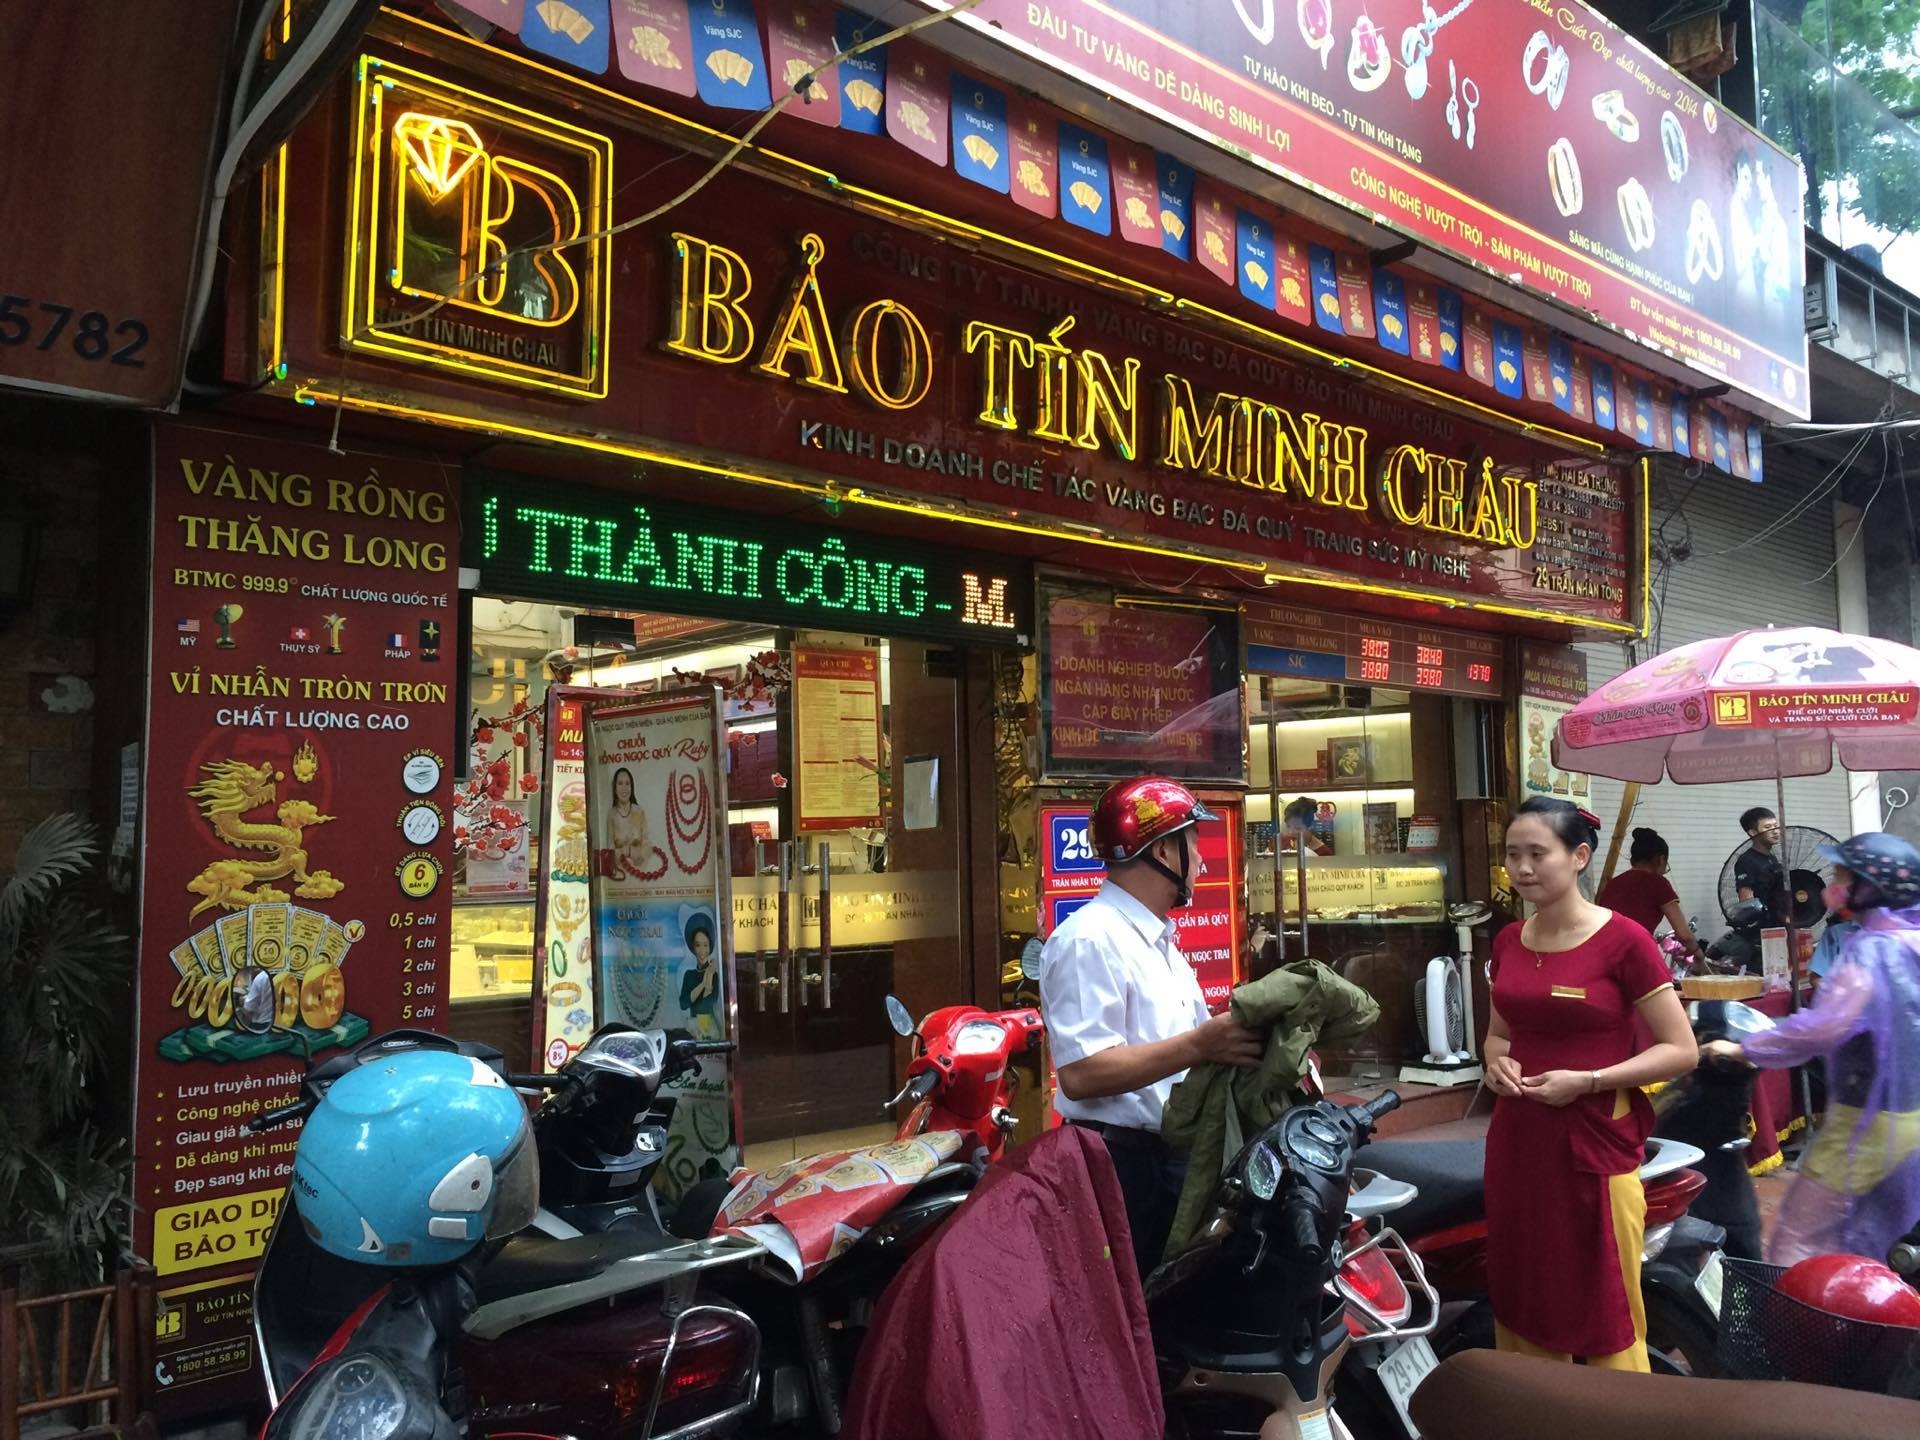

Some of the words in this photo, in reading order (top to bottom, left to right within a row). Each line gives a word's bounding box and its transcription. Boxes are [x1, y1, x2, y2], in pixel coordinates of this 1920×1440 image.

[704, 25, 724, 39] Vàng
[725, 27, 743, 39] SJC
[1071, 25, 1098, 54] TƯ
[1102, 38, 1151, 82] VÀNG
[1181, 79, 1226, 120] DÀNG
[1229, 105, 1263, 139] SINH
[1266, 123, 1291, 152] LỢI
[1243, 55, 1261, 80] TỰ
[1263, 65, 1288, 91] HÀO
[1290, 81, 1310, 104] KHI
[1311, 92, 1335, 117] ĐEO
[1342, 109, 1358, 132] TỰ
[1359, 118, 1375, 139] TIN
[1377, 127, 1395, 149] KHI
[1674, 90, 1698, 118] 2014
[965, 112, 980, 128] Vàng
[981, 120, 994, 131] SJC
[1072, 161, 1087, 176] Vàng
[1087, 166, 1097, 178] SJC
[1349, 166, 1387, 199] CÔNG
[1388, 184, 1422, 220] NGHỆ
[1424, 206, 1456, 234] VƯỢT
[1457, 220, 1483, 249] TRỘI
[1541, 262, 1570, 290] VƯỢT
[1570, 271, 1592, 298] TRỘI
[661, 232, 934, 410] BẢO
[963, 315, 1141, 461] TÍN
[1162, 372, 1368, 512] MINH
[180, 455, 312, 507] VÀNG
[326, 467, 446, 524] RỒNG
[800, 419, 876, 459] KINH
[884, 437, 984, 481] DOANH
[1052, 466, 1098, 502] TÁC
[1105, 481, 1166, 516] VÀNG
[1172, 500, 1215, 528] BẠC
[1303, 526, 1364, 557] TRANG
[178, 514, 331, 561] THĂNG
[343, 532, 447, 572] LONG
[516, 506, 763, 600] THÀNH
[775, 537, 928, 618] CÔNG
[174, 568, 236, 592] BTMC
[301, 584, 338, 600] CHẤT
[342, 586, 388, 605] LƯỢNG
[392, 588, 429, 607] QUỐC
[432, 589, 449, 608] TẾ
[180, 634, 197, 647] MỸ
[308, 644, 321, 655] SỸ
[1361, 638, 1389, 659] 3803
[385, 648, 411, 660] PHÁP
[1059, 655, 1104, 673] DOANH
[1288, 655, 1306, 669] SJC
[1416, 645, 1443, 666] 3848
[1361, 660, 1389, 681] 3880
[1416, 667, 1442, 687] 3980
[170, 664, 201, 695] VỈ
[210, 665, 290, 699] NHẪN
[300, 675, 372, 701] TRÒN
[380, 681, 447, 704] TRƠN
[1758, 693, 1790, 707] BẢO
[1792, 691, 1818, 705] TÍN
[1822, 693, 1863, 705] MINH
[1866, 690, 1910, 705] CHÂU
[216, 704, 279, 728] CHẤT
[285, 708, 360, 732] LƯỢNG
[366, 711, 410, 732] CAO
[1768, 715, 1781, 724] VÀ
[1783, 715, 1813, 723] TRANG
[623, 750, 649, 762] NGỌC
[674, 738, 710, 762] Ruby
[414, 863, 426, 881] 6
[389, 912, 414, 929] 0,5
[404, 936, 412, 949] 1
[403, 959, 413, 972] 2
[1192, 949, 1213, 962] NGỌC
[1214, 948, 1230, 960] TRAI
[402, 982, 412, 996] 3
[1205, 985, 1230, 998] NGOẠI
[402, 1005, 413, 1019] 5
[178, 1085, 209, 1099] Lưu
[214, 1074, 262, 1094] truyền
[176, 1105, 218, 1122] Công
[223, 1098, 261, 1117] nghệ
[175, 1154, 196, 1170] Dễ
[201, 1149, 239, 1166] dàng
[243, 1143, 266, 1158] khi
[174, 1179, 205, 1196] Đẹp
[208, 1171, 245, 1188] sang
[249, 1165, 271, 1181] khi
[171, 1204, 242, 1232] GIAO
[174, 1235, 236, 1262] BẢO
